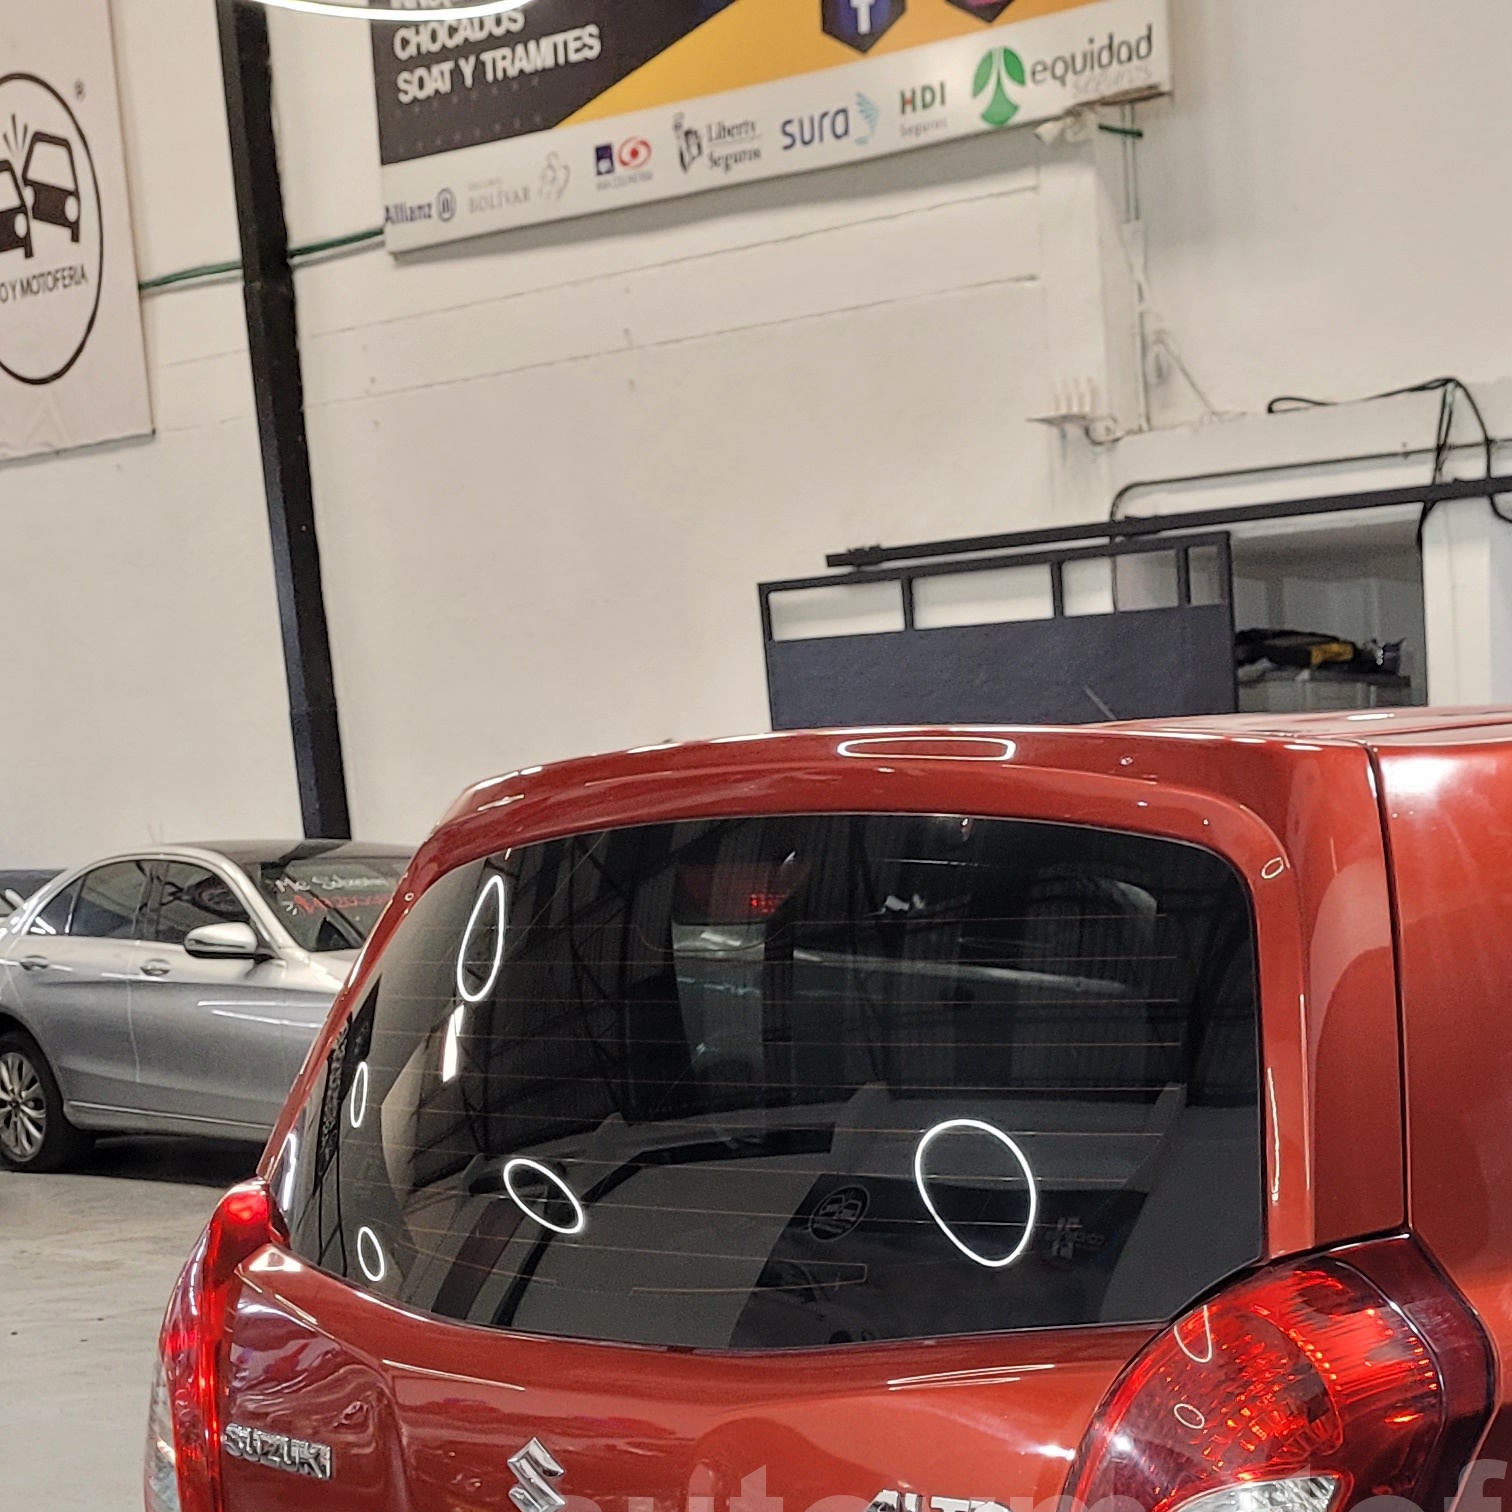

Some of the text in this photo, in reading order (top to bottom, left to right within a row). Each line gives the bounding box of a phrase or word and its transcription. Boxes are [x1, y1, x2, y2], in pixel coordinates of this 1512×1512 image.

[393, 10, 525, 61] CHOCADOS
[1030, 23, 1153, 87] equidad
[397, 23, 602, 104] SOAT Y TRAMITES
[900, 80, 946, 116] HDI
[706, 120, 758, 142] Liberty
[781, 106, 850, 150] sura
[384, 201, 433, 225] Allianz
[20, 263, 88, 299] MOTOFERIA
[224, 1423, 332, 1481] SUZUKI
